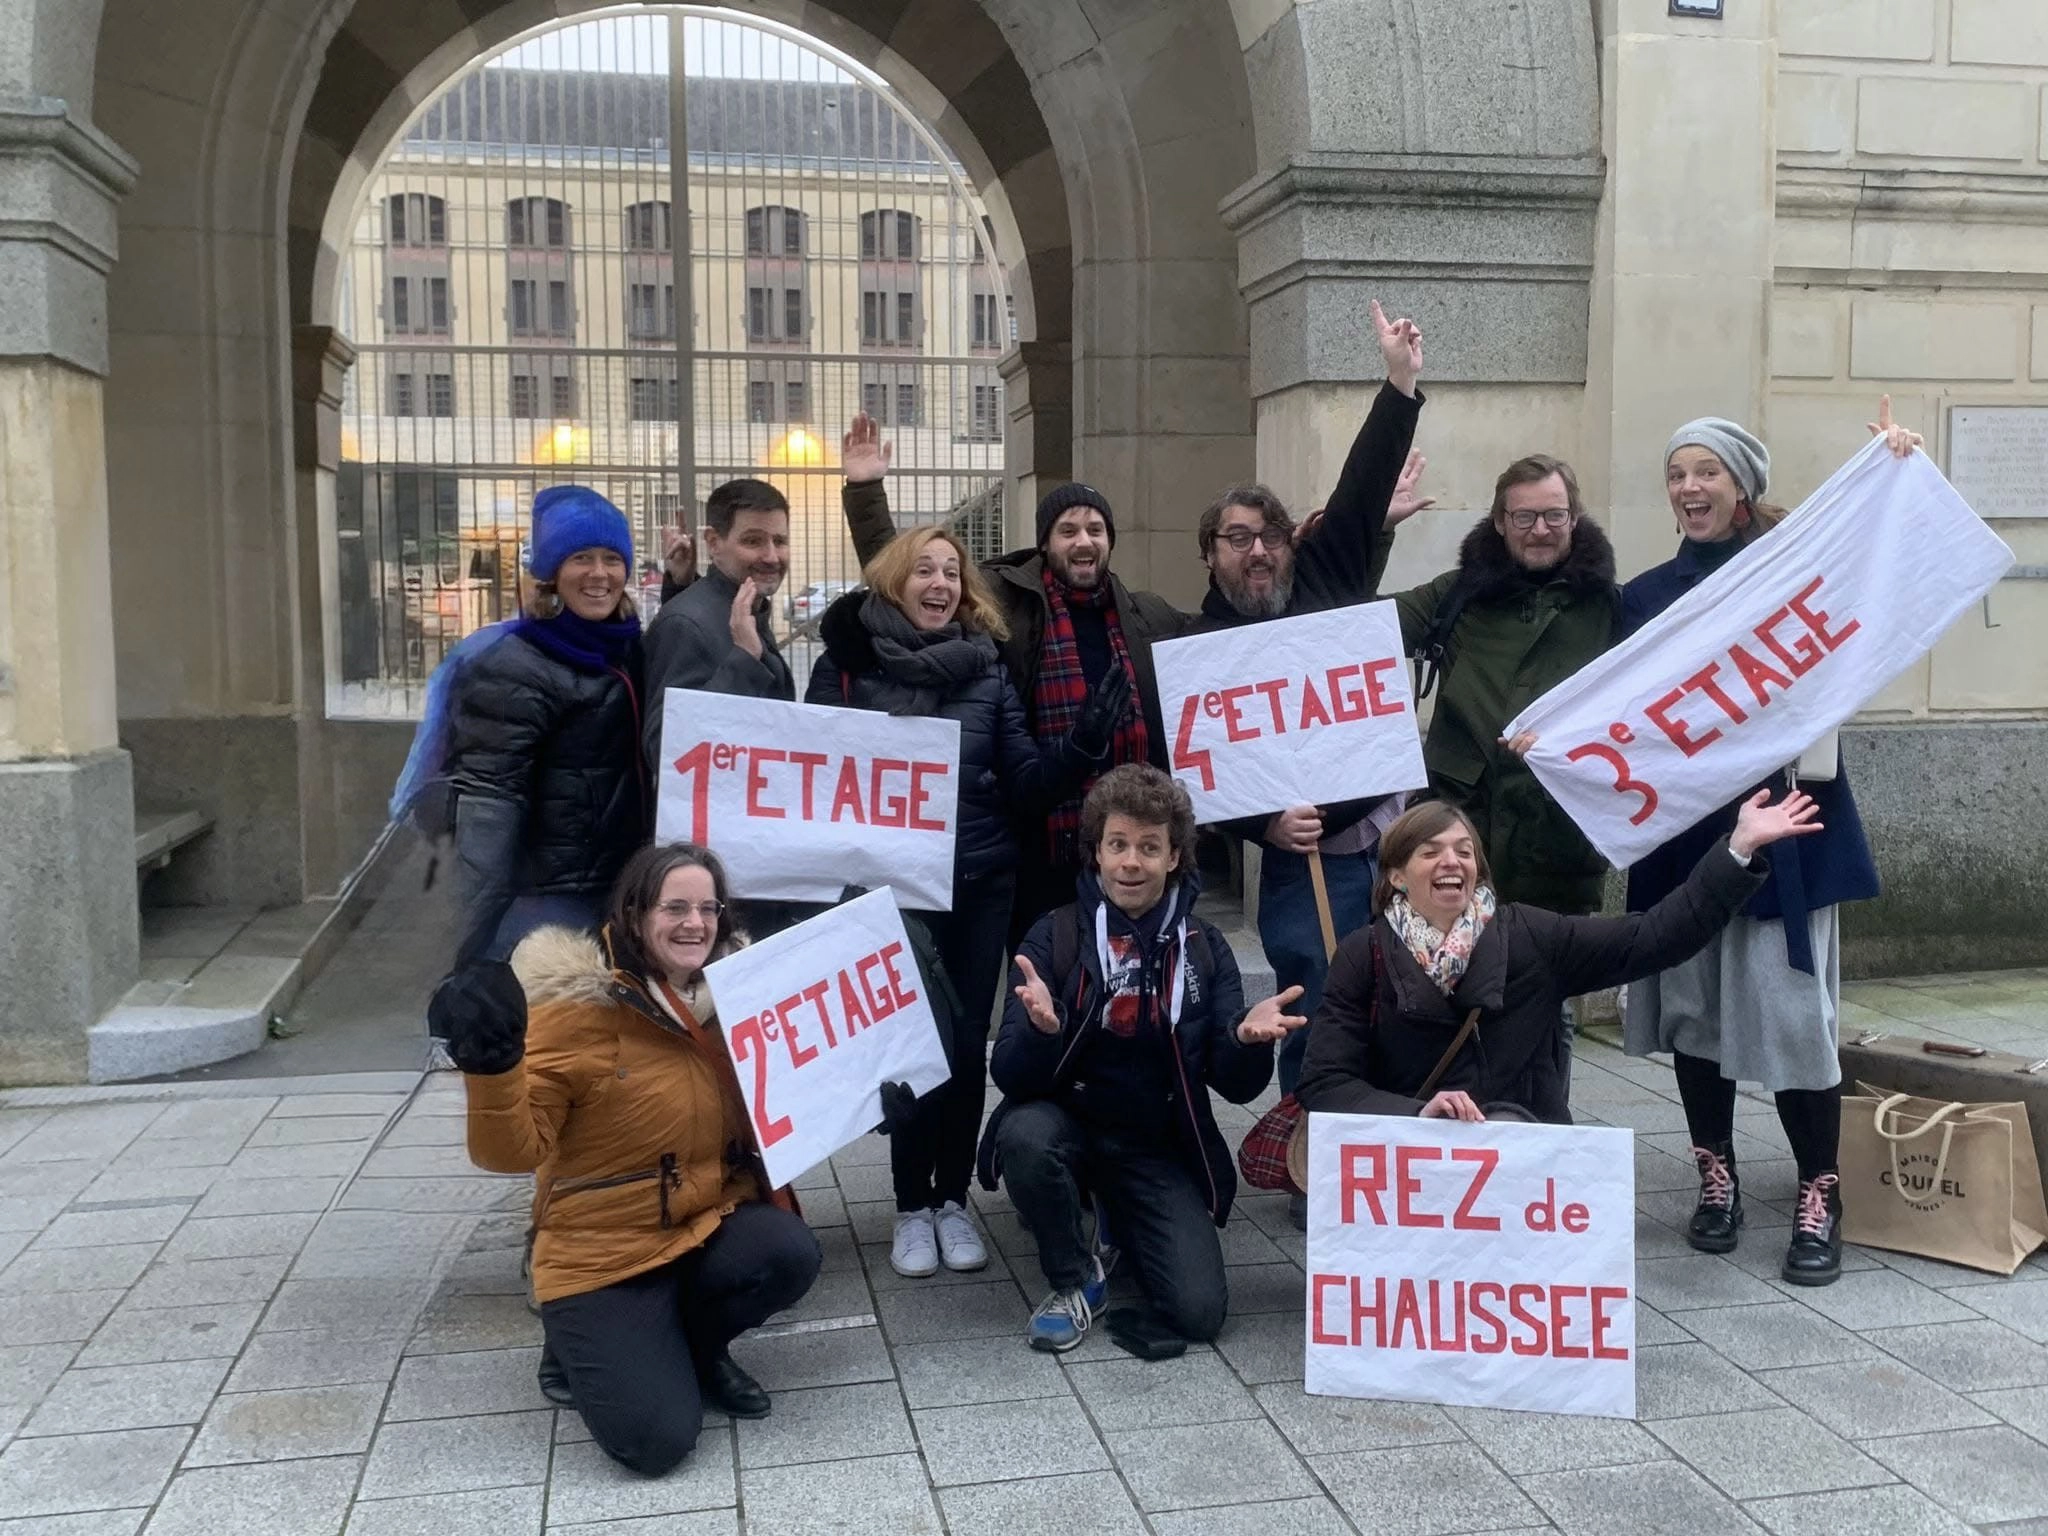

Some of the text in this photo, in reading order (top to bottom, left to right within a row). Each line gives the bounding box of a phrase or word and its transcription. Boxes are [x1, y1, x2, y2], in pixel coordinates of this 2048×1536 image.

[1172, 657, 1406, 792] 4e ETAGE
[1565, 574, 1861, 826] 3e ETAGE
[673, 740, 949, 848] 1er ETAGE
[730, 940, 918, 1149] 2e ETAGE
[1340, 1143, 1591, 1233] REZ de
[1900, 1153, 1947, 1174] MAISO
[1312, 1273, 1630, 1361] CHAUSSEE
